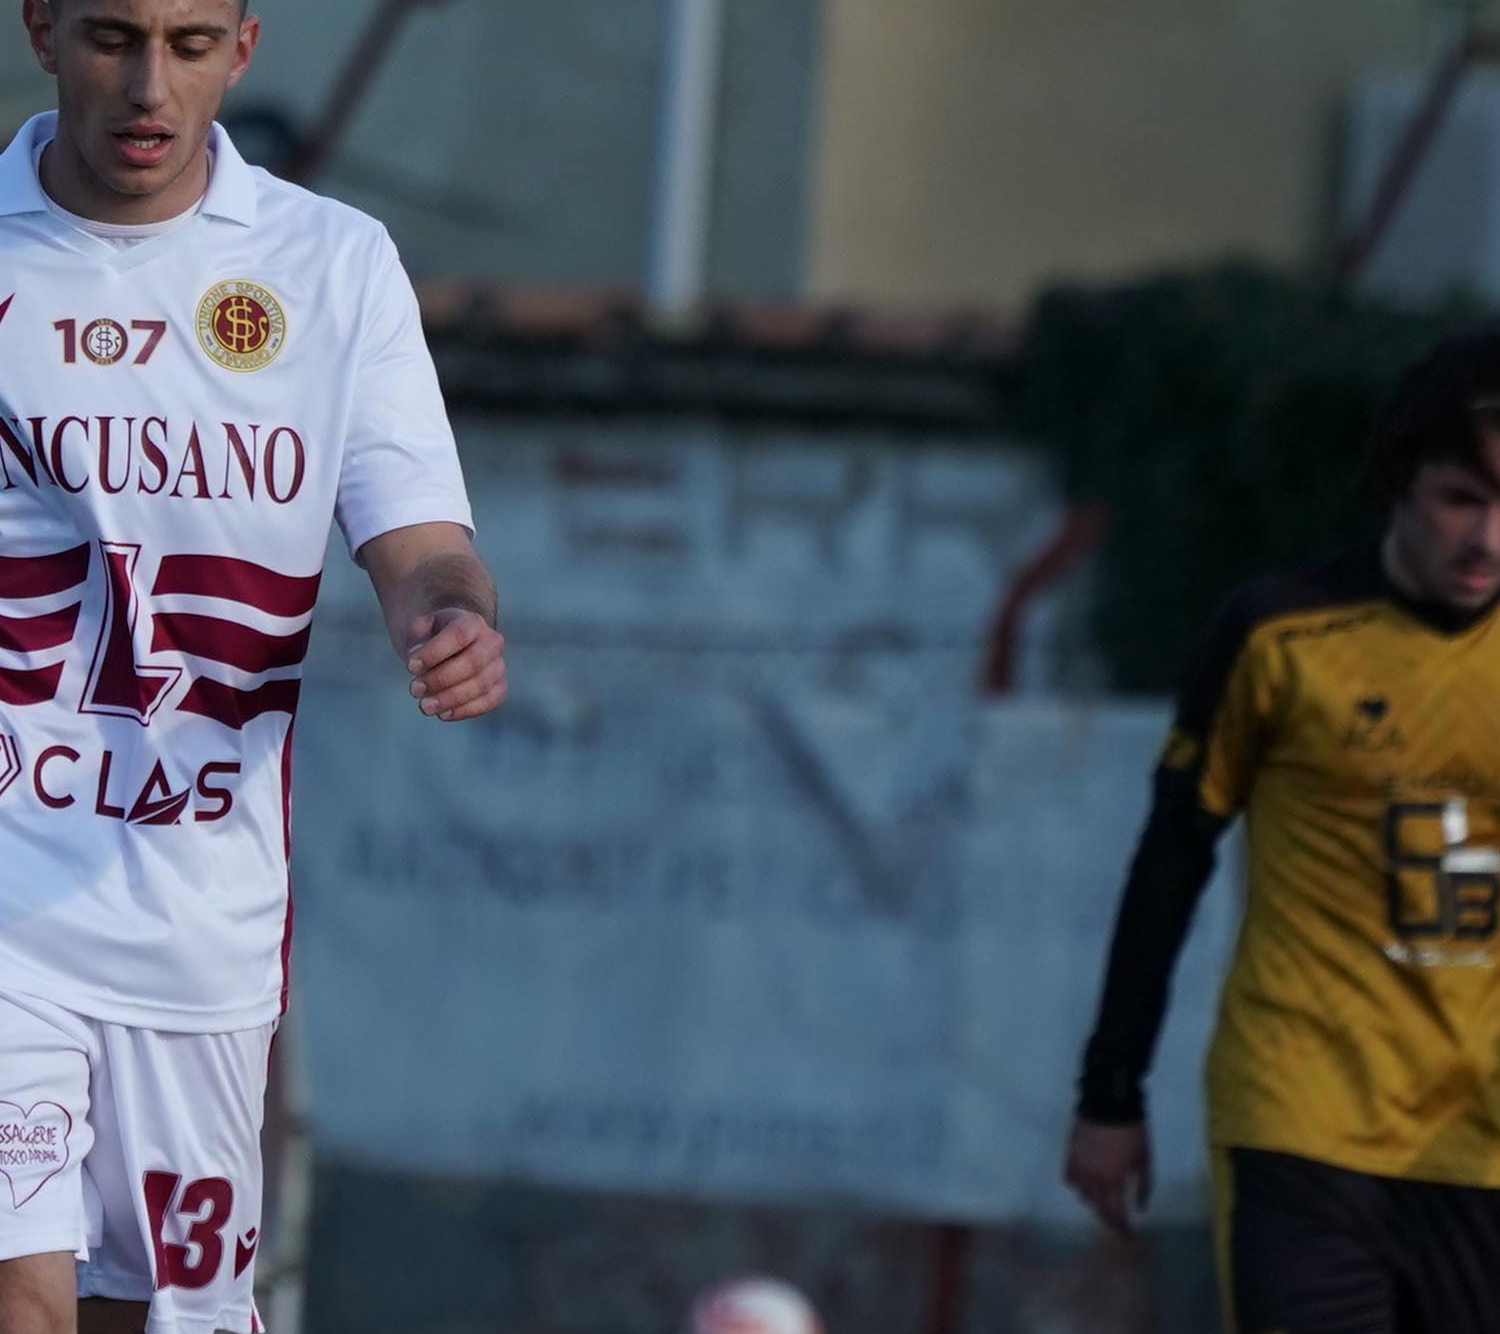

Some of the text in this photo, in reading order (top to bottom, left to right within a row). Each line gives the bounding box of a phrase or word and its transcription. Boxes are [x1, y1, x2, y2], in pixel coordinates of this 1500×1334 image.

[52, 317, 168, 366] 107
[33, 744, 242, 826] CLAS
[142, 1169, 234, 1293] 13
